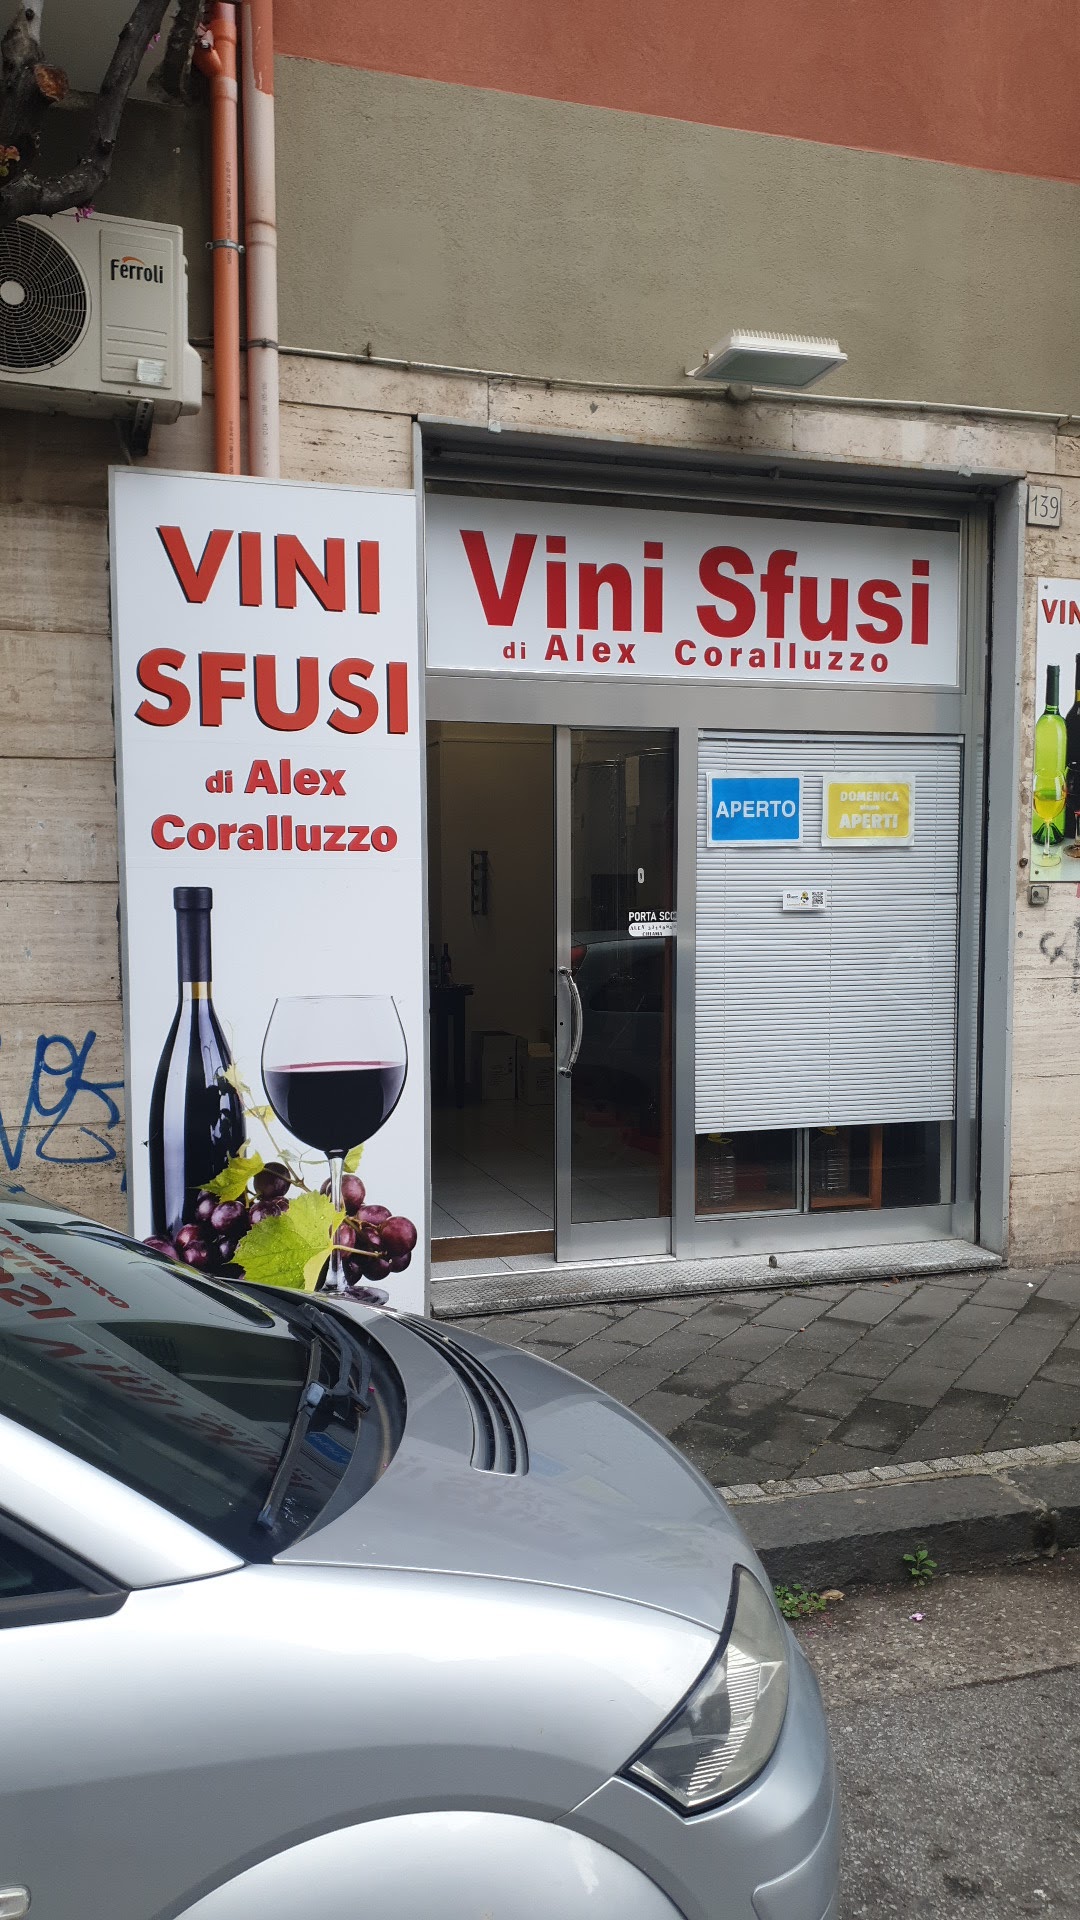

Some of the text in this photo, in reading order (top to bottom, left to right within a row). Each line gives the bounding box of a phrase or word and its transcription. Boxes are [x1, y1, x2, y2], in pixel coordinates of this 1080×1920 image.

[110, 258, 163, 284] Ferroli
[1031, 495, 1059, 519] 139
[156, 525, 381, 614] VINI
[460, 530, 930, 645] Vini Sfusi
[502, 634, 889, 673] di Alex Coralluzzo
[135, 647, 409, 735] SFUSI
[206, 759, 347, 796] di Alex
[716, 800, 796, 818] APERTO
[840, 791, 899, 802] DOMENICA
[151, 814, 398, 852] Coralluzzo
[839, 813, 899, 829] APERTI
[628, 911, 657, 922] PORTA
